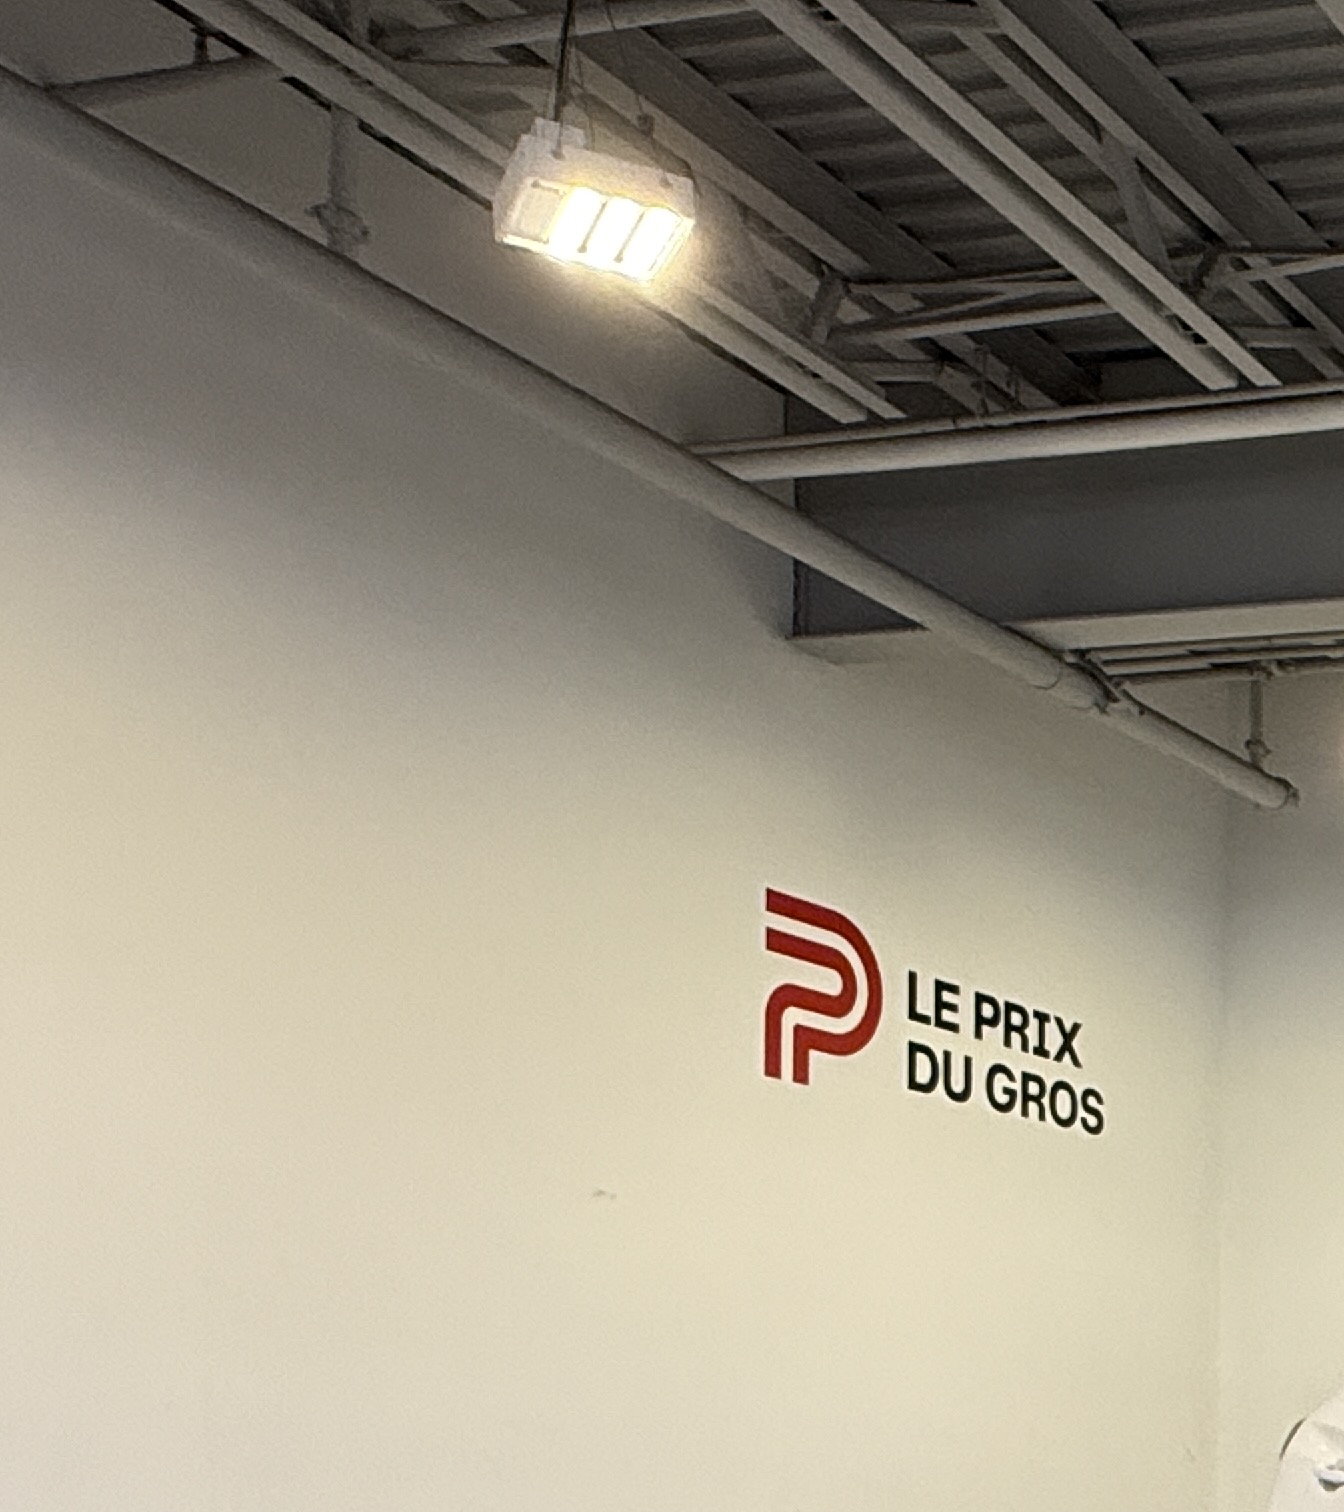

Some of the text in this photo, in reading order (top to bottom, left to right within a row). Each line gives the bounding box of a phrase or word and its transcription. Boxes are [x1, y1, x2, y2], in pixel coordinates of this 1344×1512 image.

[907, 968, 1084, 1070] LE PRIX
[906, 1039, 1106, 1138] DU GROS
